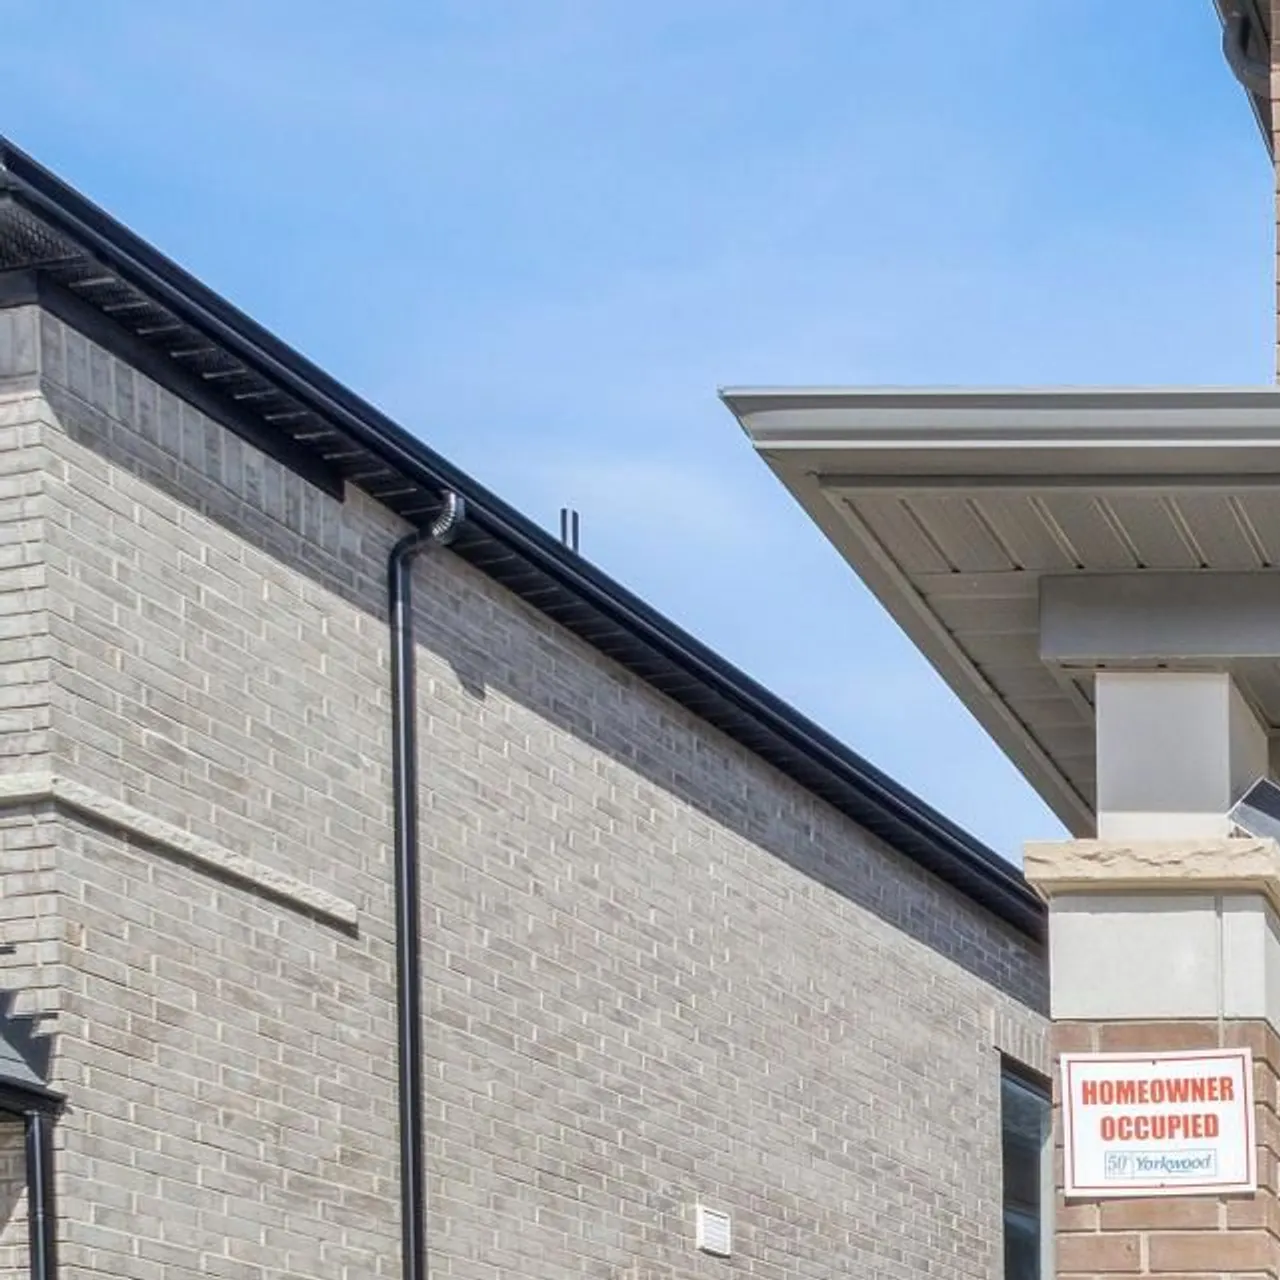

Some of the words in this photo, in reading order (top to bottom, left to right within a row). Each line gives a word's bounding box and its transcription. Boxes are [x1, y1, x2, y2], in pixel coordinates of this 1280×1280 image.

[1081, 1076, 1234, 1105] HOMEOWNER
[1100, 1113, 1219, 1141] OCCUPIED
[1136, 1154, 1212, 1173] Yorkwood
